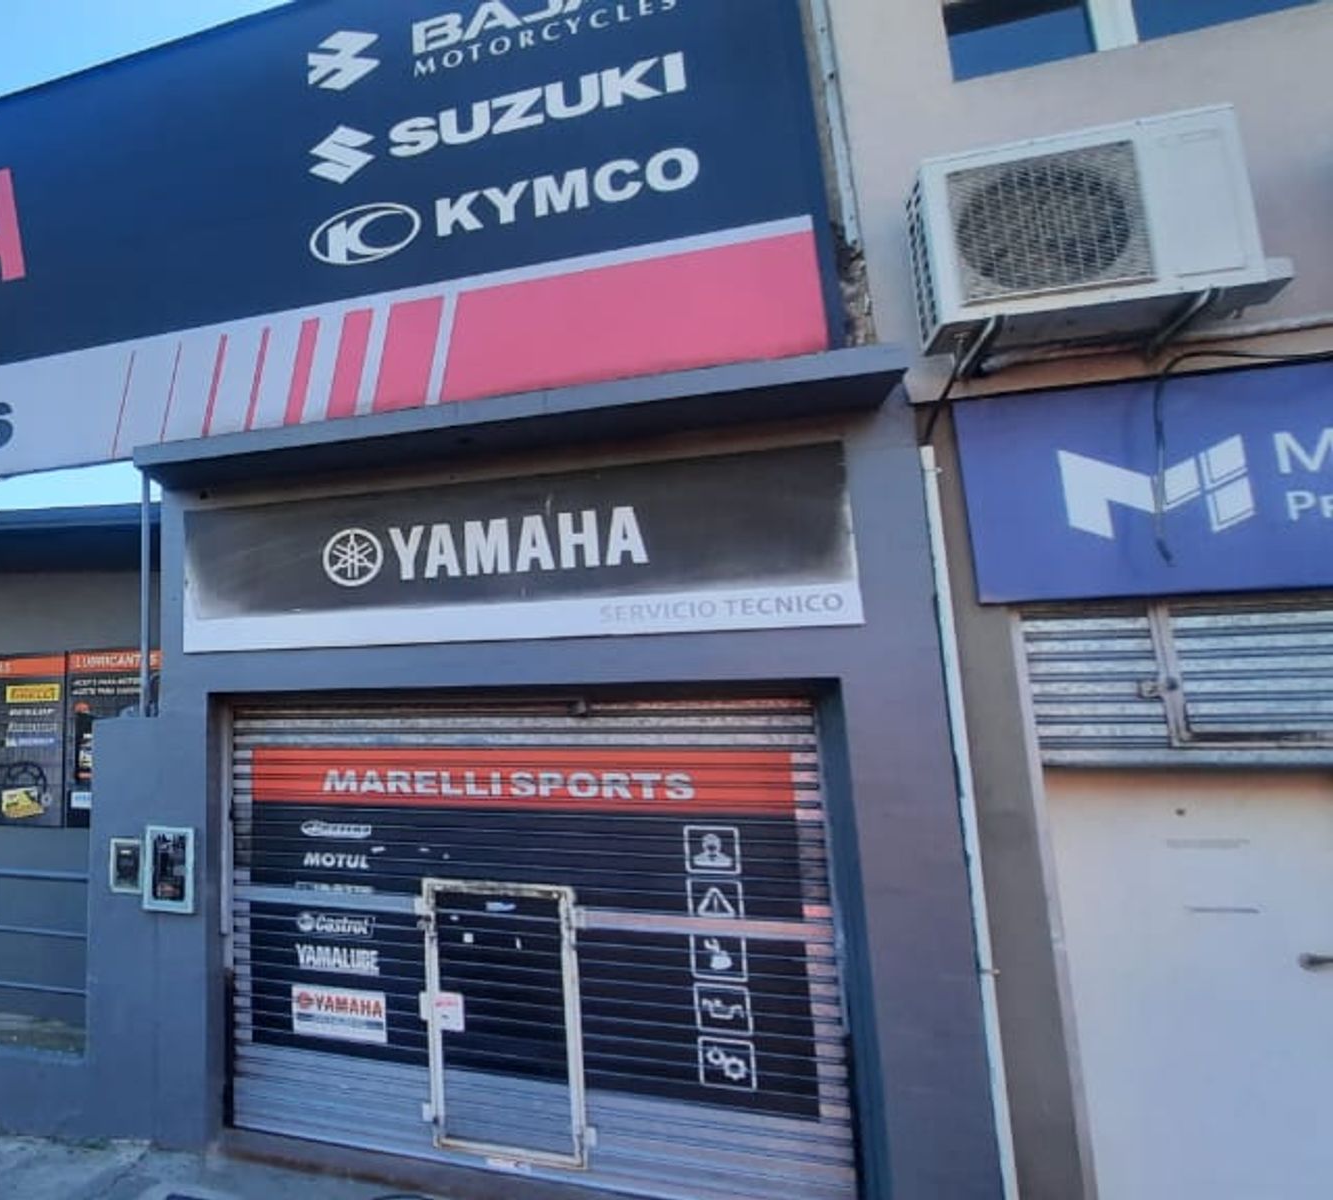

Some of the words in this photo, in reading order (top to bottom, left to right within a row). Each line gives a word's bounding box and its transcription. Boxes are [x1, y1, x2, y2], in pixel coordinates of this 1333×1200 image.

[412, 0, 590, 54] BAJ
[414, 0, 678, 77] MOTORCYCLES
[388, 51, 687, 158] SUZUKI
[435, 147, 700, 237] KYMCO
[388, 506, 650, 581] YAMAHA
[599, 601, 717, 624] SERVICIO
[724, 593, 844, 618] TECNICO
[76, 655, 160, 669] LUBRICANTS
[303, 851, 370, 870] MOTUL
[315, 915, 369, 936] Castrol
[295, 944, 381, 975] YAMALUBE
[315, 992, 383, 1019] YAMAHA
